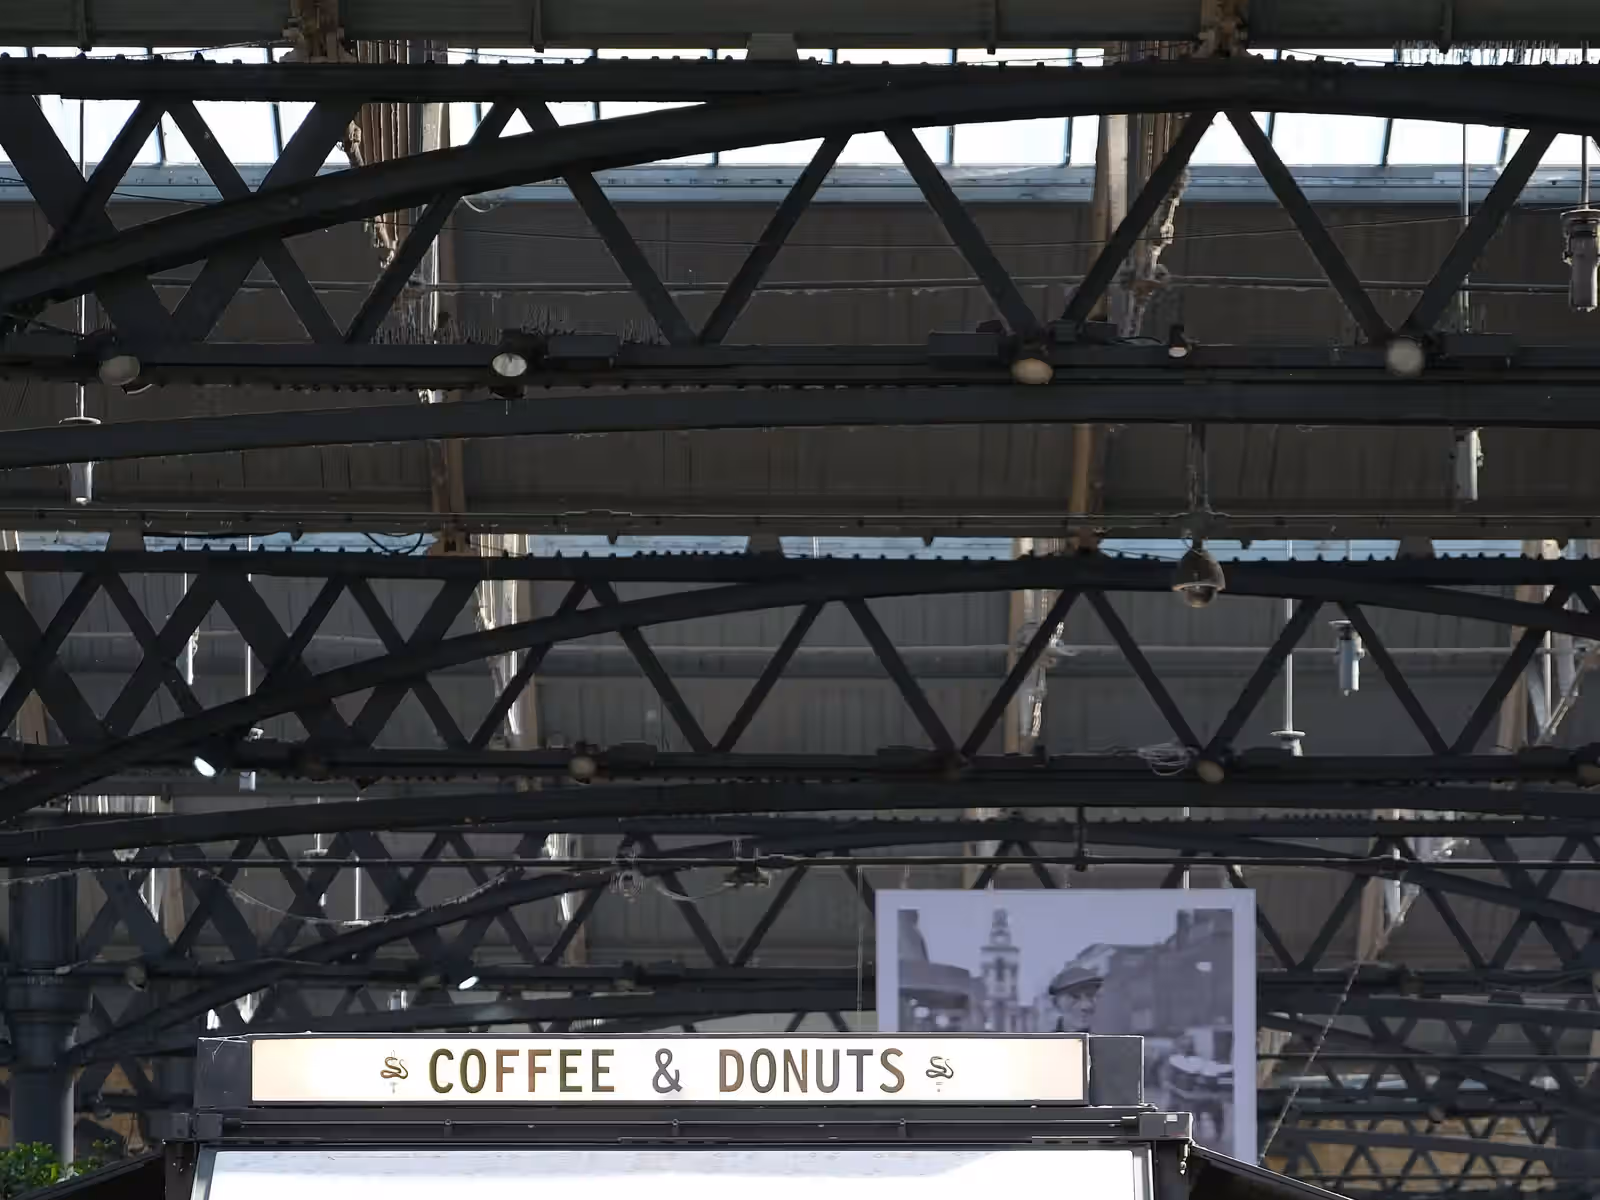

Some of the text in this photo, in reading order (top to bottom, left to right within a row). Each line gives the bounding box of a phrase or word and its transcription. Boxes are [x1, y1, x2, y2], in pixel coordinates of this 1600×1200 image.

[428, 1047, 906, 1094] COFFEE & DONUTS
